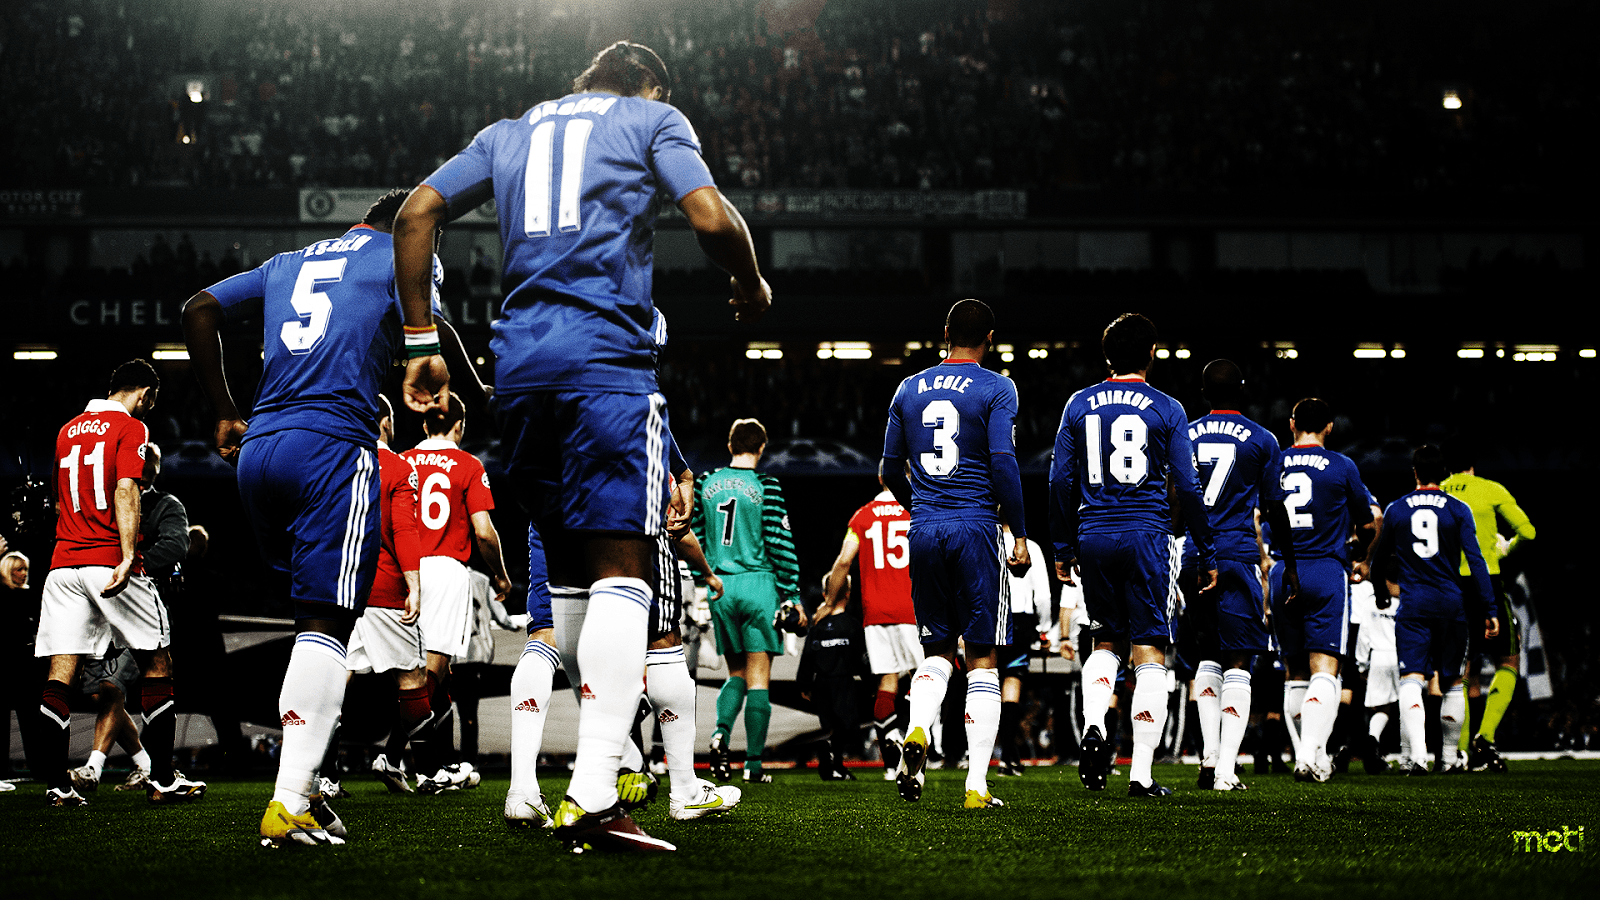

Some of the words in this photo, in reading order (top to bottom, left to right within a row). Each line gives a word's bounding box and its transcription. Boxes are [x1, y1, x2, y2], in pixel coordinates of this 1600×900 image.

[524, 118, 594, 238] 11
[69, 300, 184, 325] CHEL
[279, 257, 347, 356] 5
[918, 375, 974, 394] A.COLE
[1087, 390, 1154, 411] ZHIRKOV
[67, 419, 111, 439] GIGGS
[920, 400, 960, 480] 3
[1085, 414, 1149, 488] 18
[60, 441, 108, 513] 11
[421, 472, 452, 531] 6
[1197, 443, 1237, 507] 7
[1283, 472, 1314, 530] 2
[716, 497, 737, 547] 1
[872, 504, 905, 517] VIDIC
[1411, 508, 1440, 559] 9
[865, 520, 911, 570] 15
